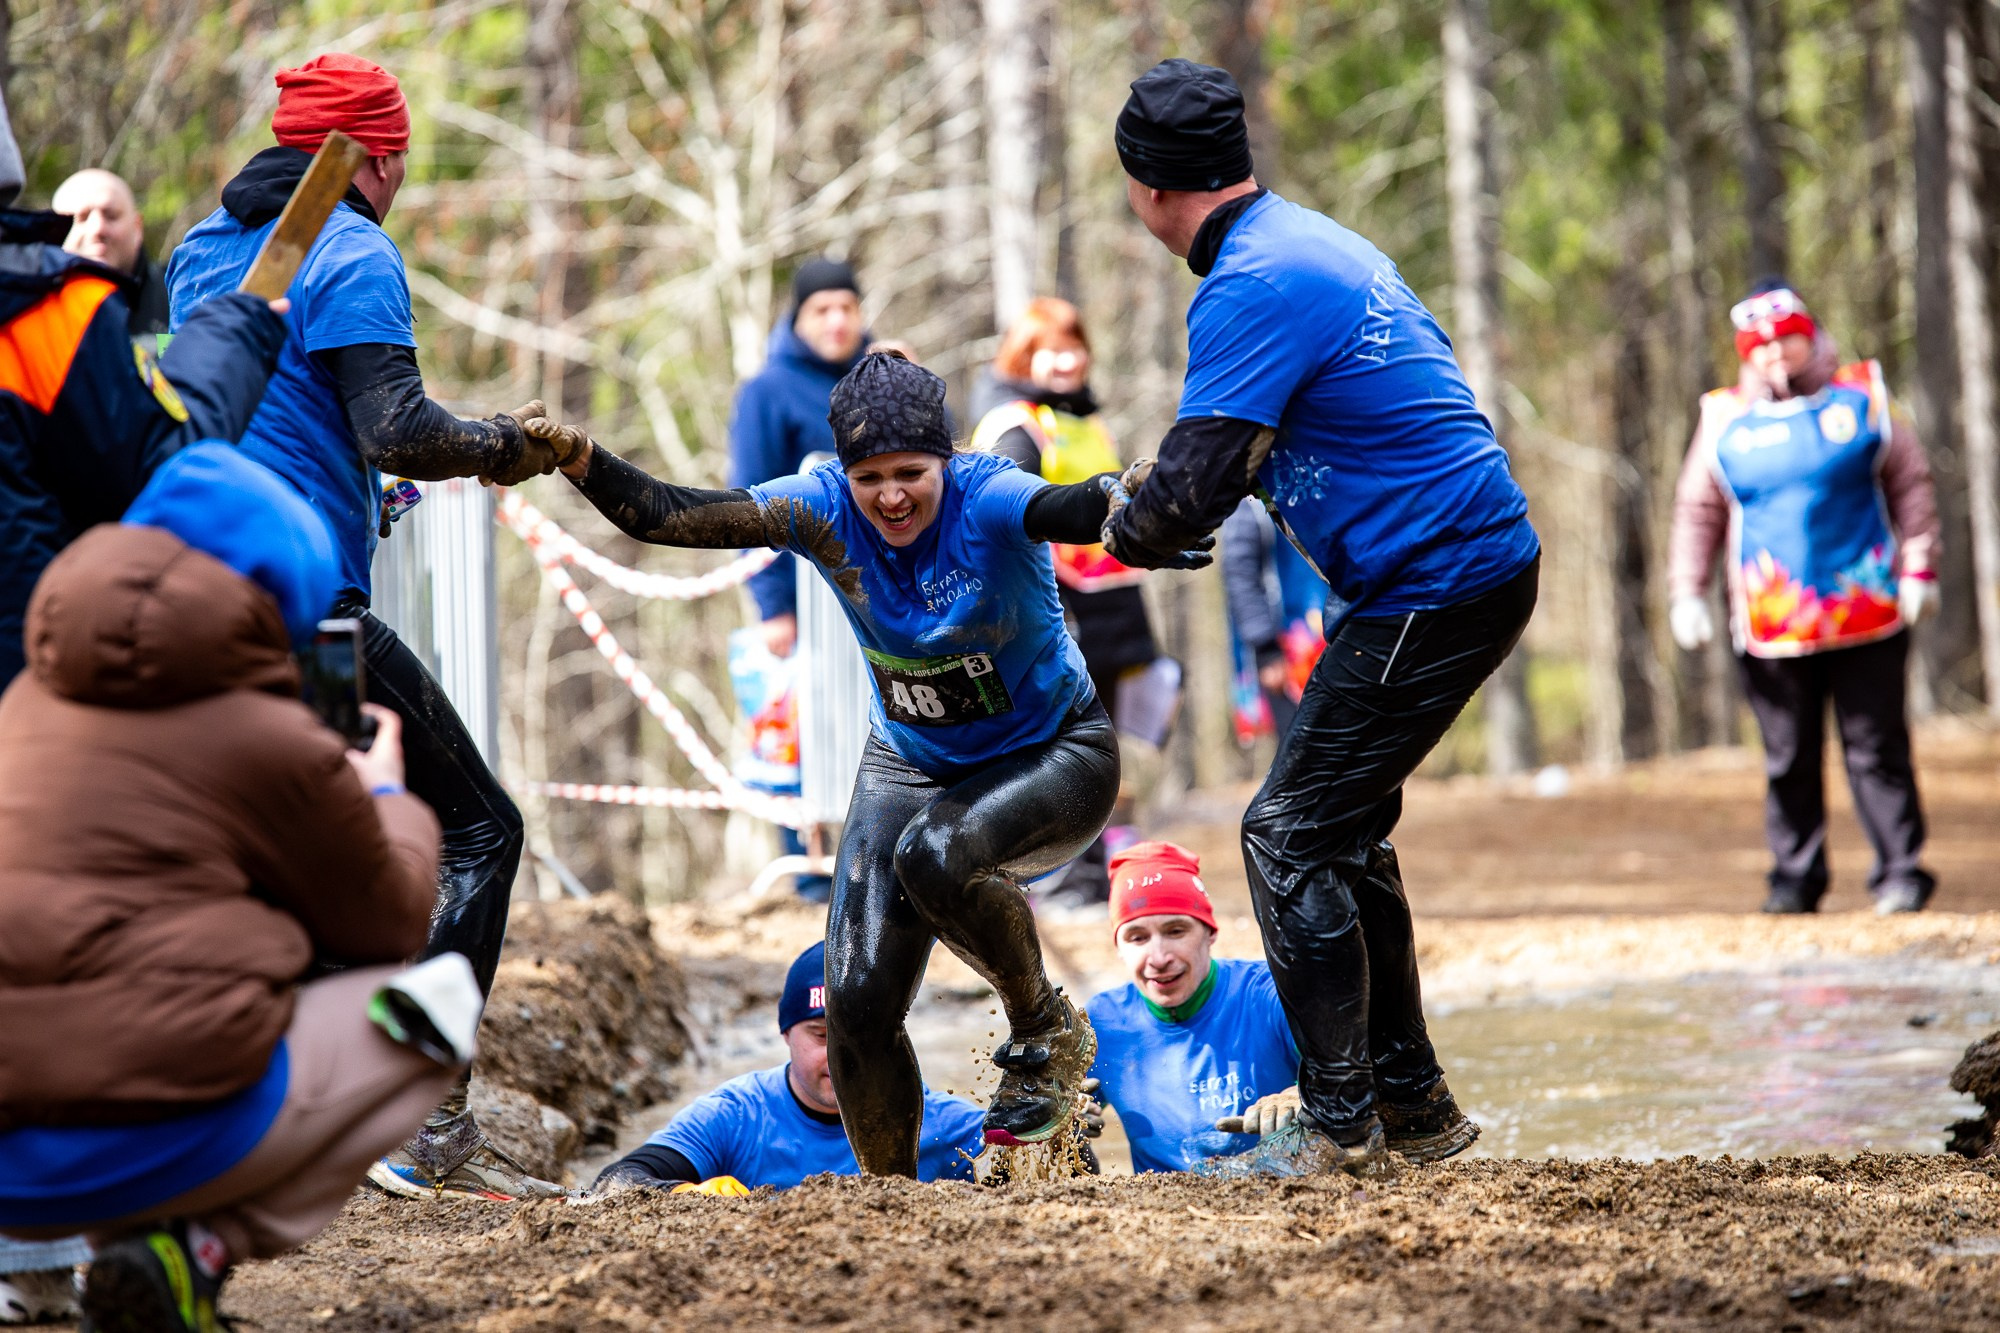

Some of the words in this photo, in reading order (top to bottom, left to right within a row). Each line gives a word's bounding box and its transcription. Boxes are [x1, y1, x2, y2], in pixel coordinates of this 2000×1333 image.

[921, 569, 968, 596] БЕГАТЬ
[935, 577, 983, 608] МОДНО
[913, 667, 942, 677] АПРЕЛЯ
[943, 661, 961, 672] 2025
[968, 656, 987, 673] 3
[891, 680, 946, 718] 48
